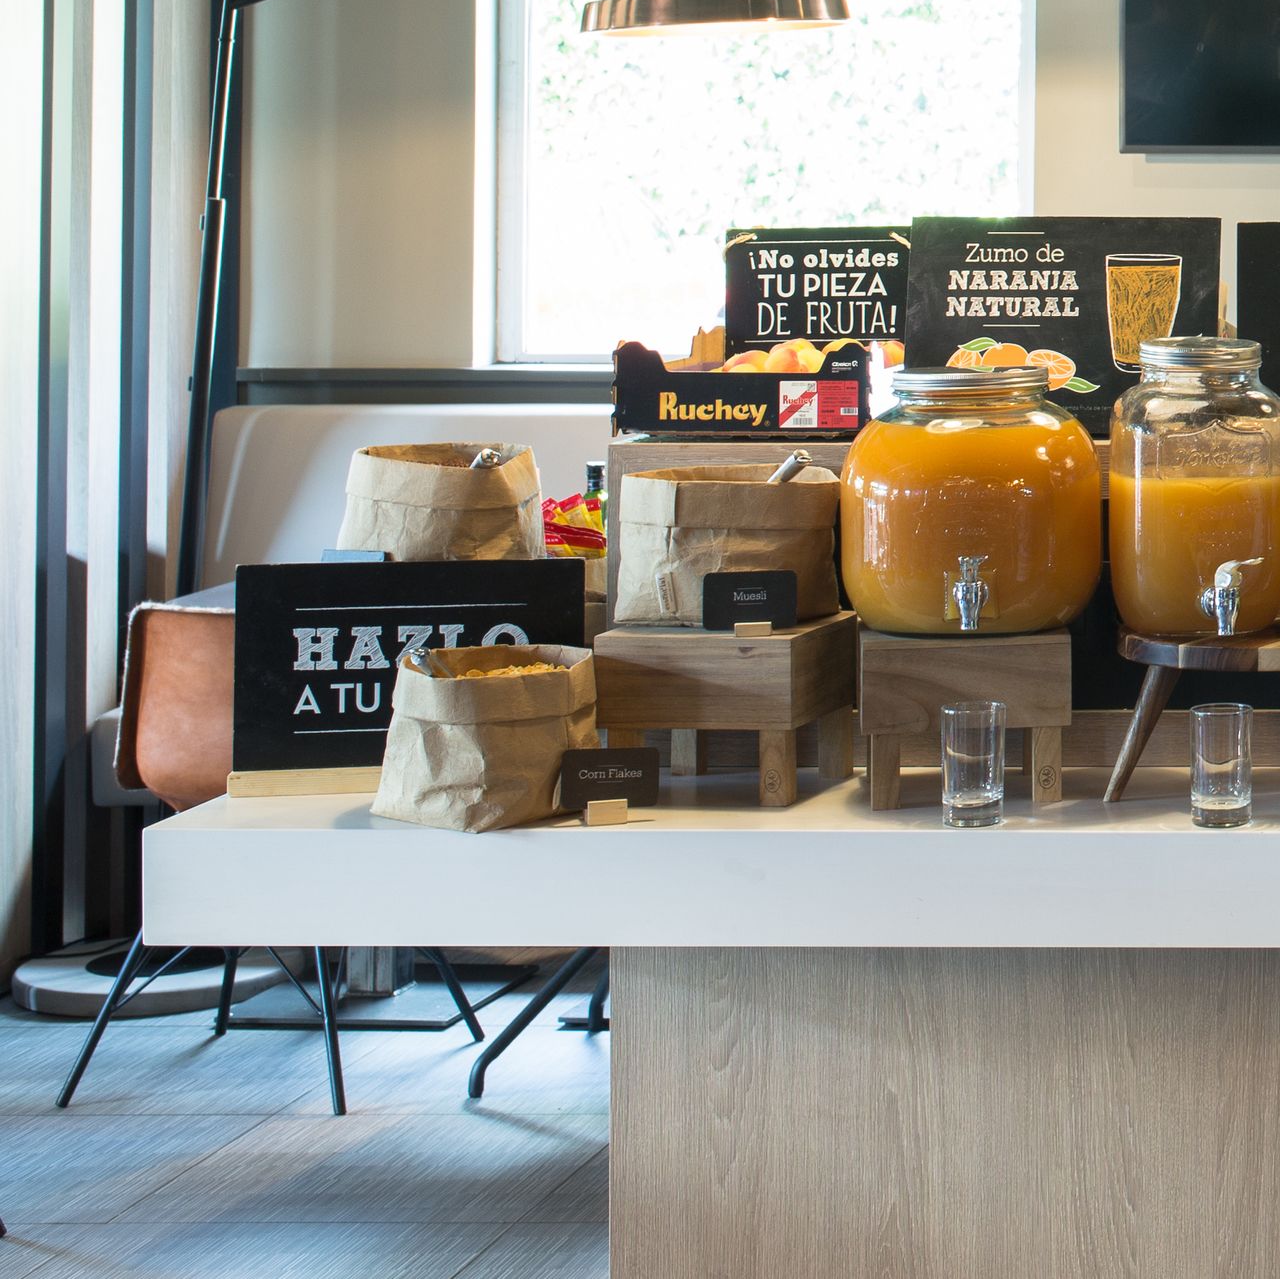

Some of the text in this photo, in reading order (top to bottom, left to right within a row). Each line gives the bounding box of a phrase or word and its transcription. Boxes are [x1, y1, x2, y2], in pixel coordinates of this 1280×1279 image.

[749, 248, 899, 271] ¡No olvides
[966, 243, 1065, 264] Zumo de
[758, 272, 888, 298] TU PIEZA
[948, 270, 1079, 291] NARANJA
[757, 301, 897, 336] DE FRUTA!
[946, 297, 1079, 318] NATURAL
[659, 391, 767, 426] Ruchey
[733, 590, 767, 602] Muesli
[293, 683, 381, 715] A TU
[578, 768, 643, 780] Corn Flakes
